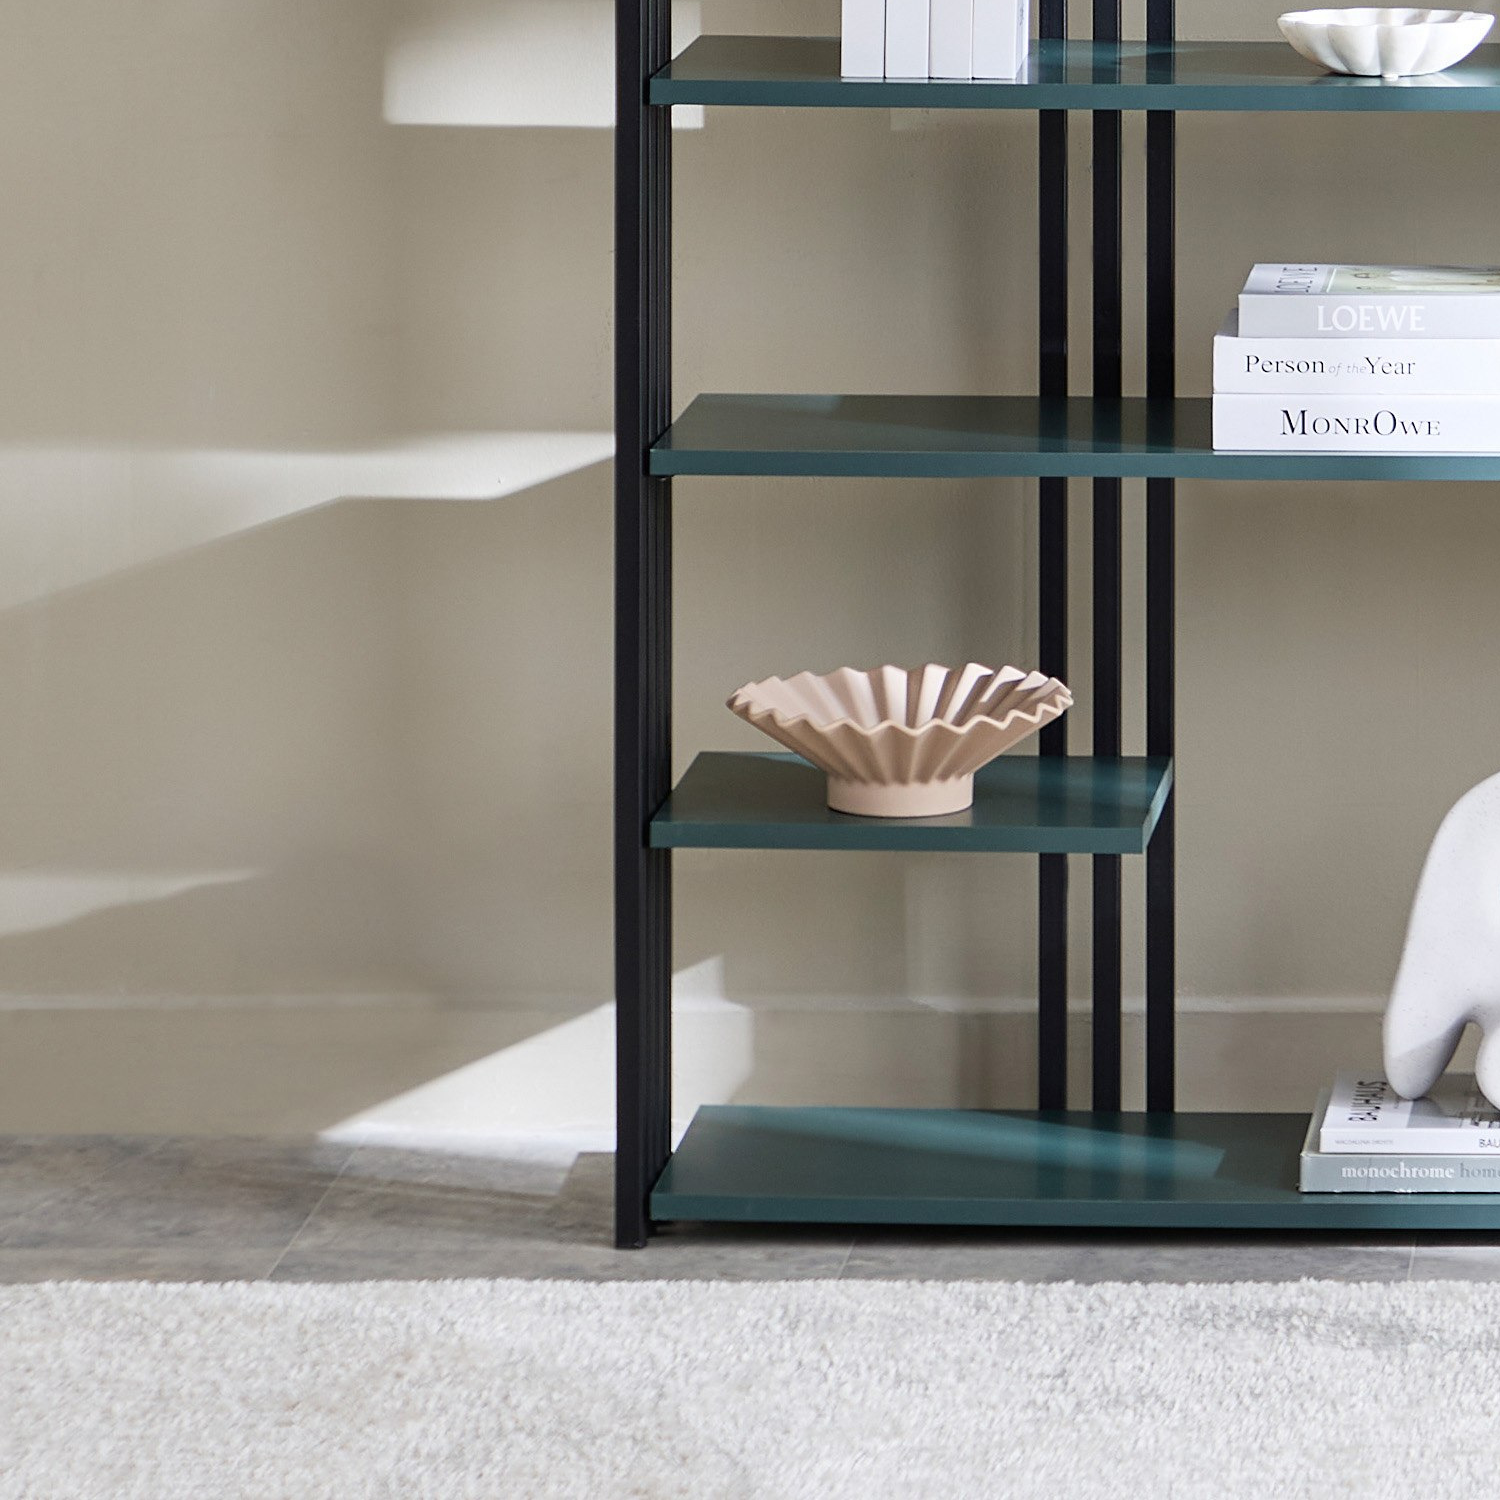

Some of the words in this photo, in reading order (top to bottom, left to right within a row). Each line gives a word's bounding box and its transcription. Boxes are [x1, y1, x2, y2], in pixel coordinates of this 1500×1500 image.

[1316, 305, 1426, 332] LOEWE
[1245, 355, 1325, 374] Person
[1328, 362, 1343, 377] of
[1347, 362, 1366, 374] the
[1364, 356, 1416, 375] Year
[1348, 1080, 1388, 1122] BAUHAUS
[1340, 1160, 1455, 1179] monochrome
